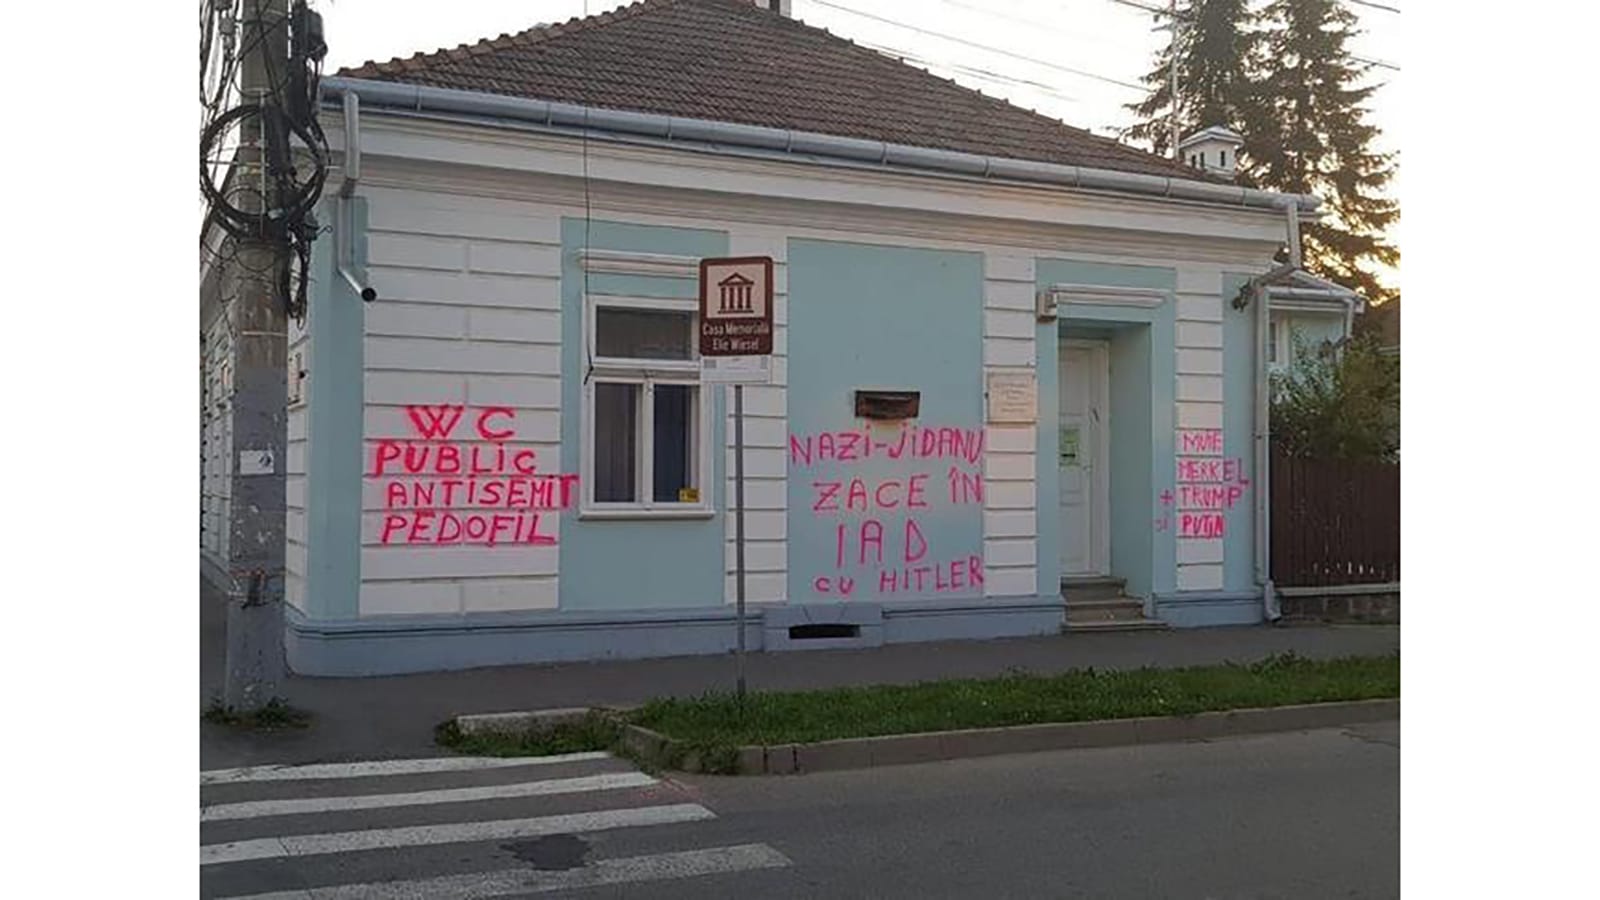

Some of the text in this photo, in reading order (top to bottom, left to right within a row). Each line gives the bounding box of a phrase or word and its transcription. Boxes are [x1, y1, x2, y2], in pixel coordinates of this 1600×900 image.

[1178, 457, 1249, 487] MERKEL
[812, 473, 929, 512] ZACE
[1180, 485, 1242, 510] TRUMP
[836, 518, 928, 569] IAD
[879, 555, 984, 593] HITLER
